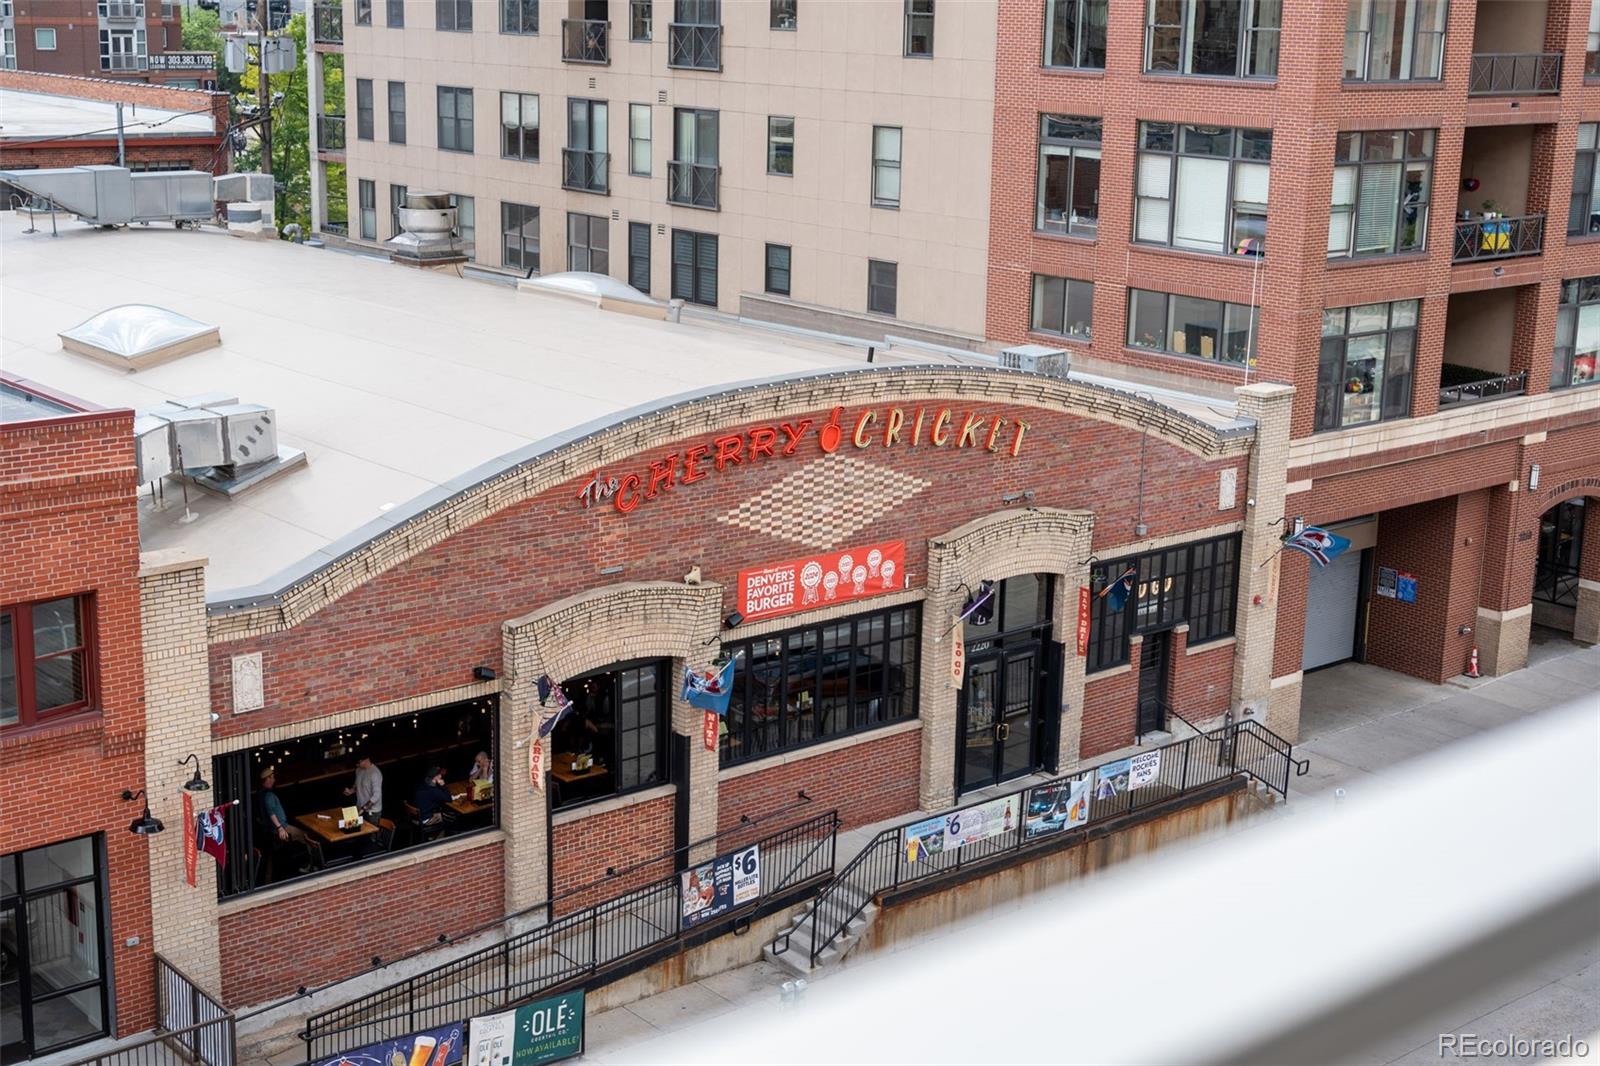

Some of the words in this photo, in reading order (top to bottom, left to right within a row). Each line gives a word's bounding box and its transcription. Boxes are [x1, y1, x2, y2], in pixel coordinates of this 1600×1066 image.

[149, 55, 166, 64] NOW
[167, 55, 213, 64] 303.383.1700
[576, 470, 619, 509] The
[614, 420, 812, 512] CHERRY
[852, 405, 1031, 456] CRICKET
[747, 569, 795, 588] DENVER'S
[747, 580, 795, 600] FAVORITE
[746, 592, 794, 613] BURGER
[531, 739, 542, 789] ARCADE
[735, 850, 757, 875] $6
[531, 999, 568, 1036] OLÉ
[515, 1047, 535, 1058] NOW
